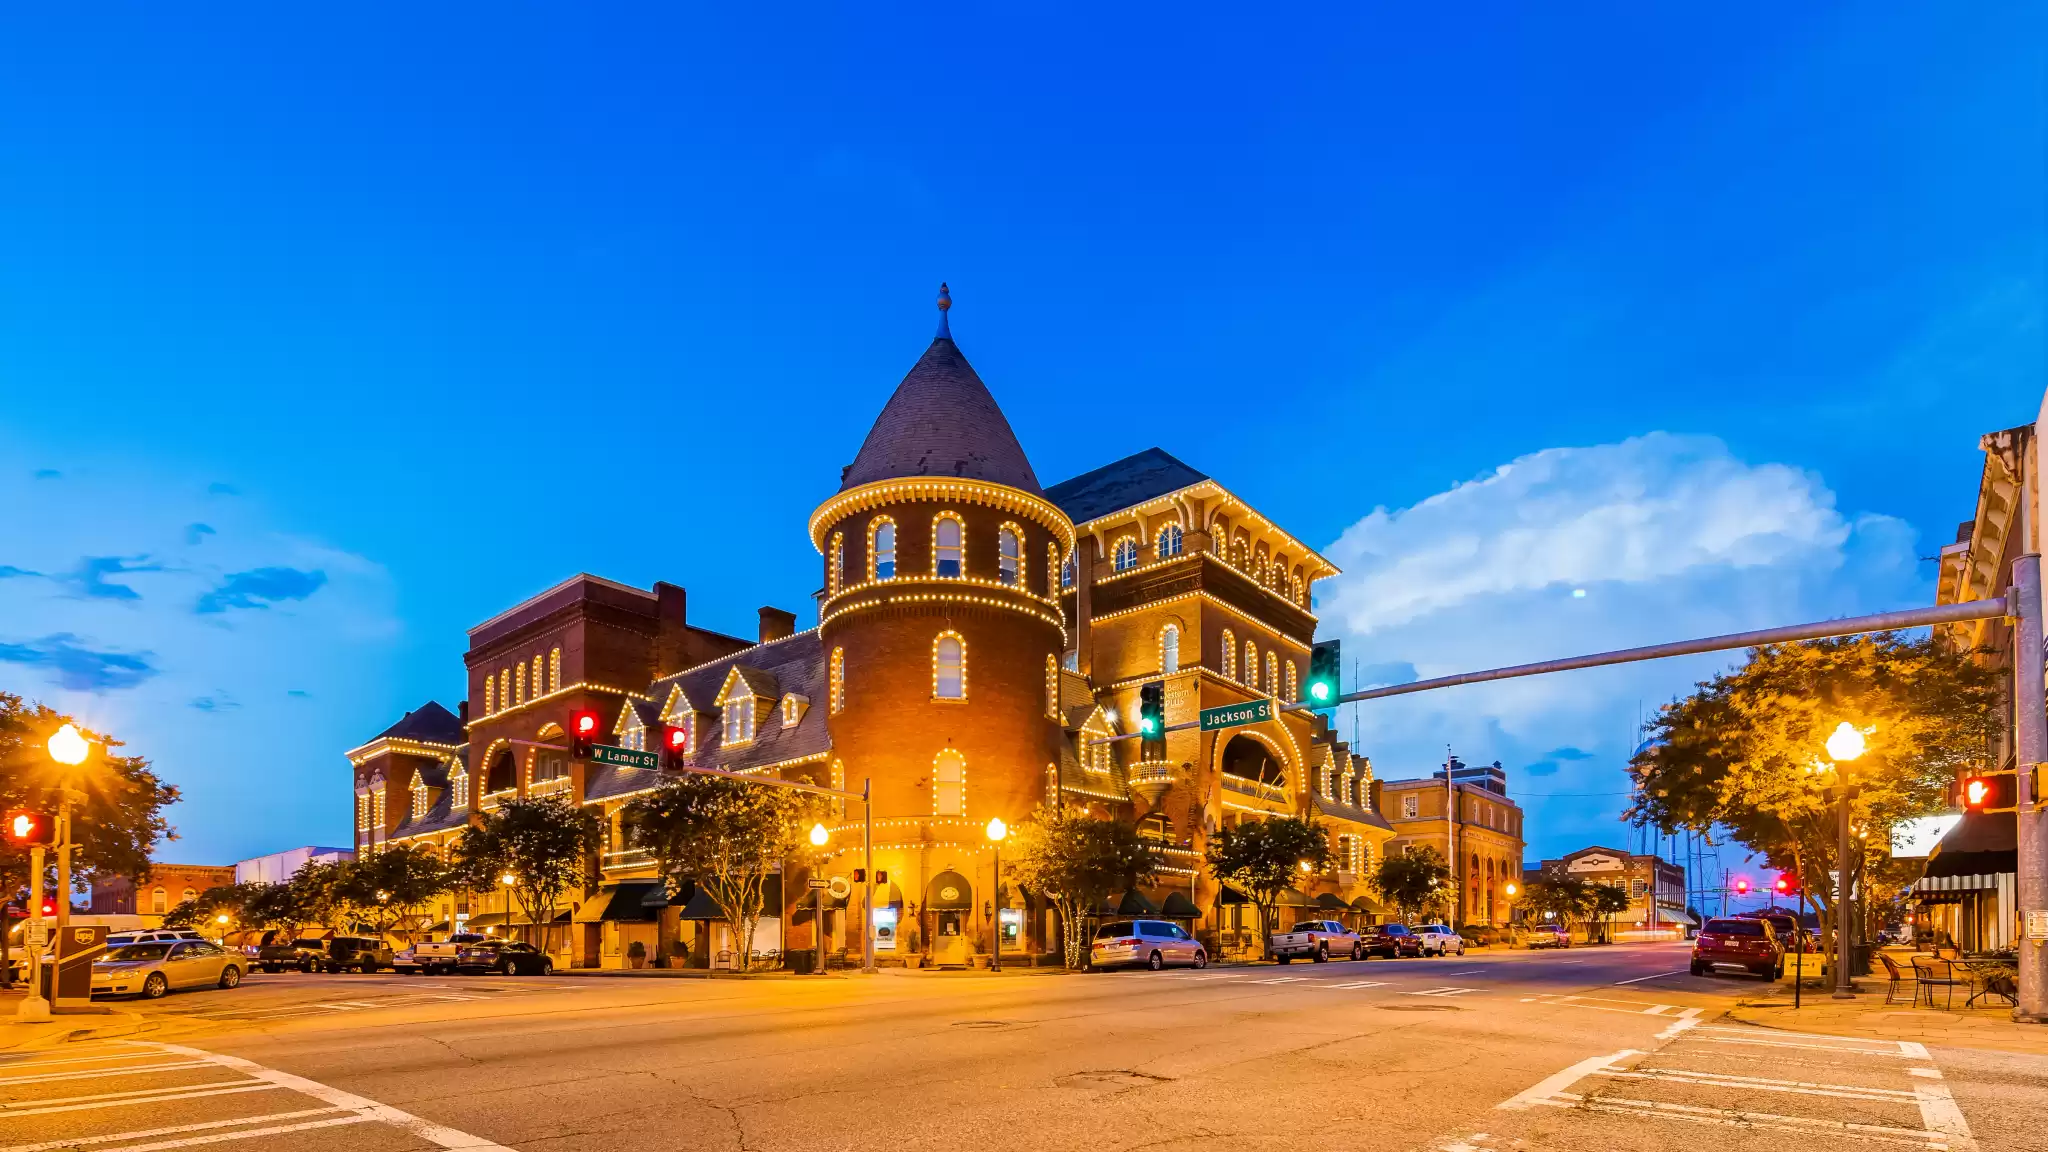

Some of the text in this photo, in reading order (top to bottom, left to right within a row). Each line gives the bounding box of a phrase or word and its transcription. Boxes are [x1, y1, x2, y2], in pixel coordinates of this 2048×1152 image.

[1167, 681, 1183, 691] Best
[1206, 709, 1253, 726] Jackson
[1258, 704, 1271, 717] St
[594, 748, 655, 767] W Lamar St
